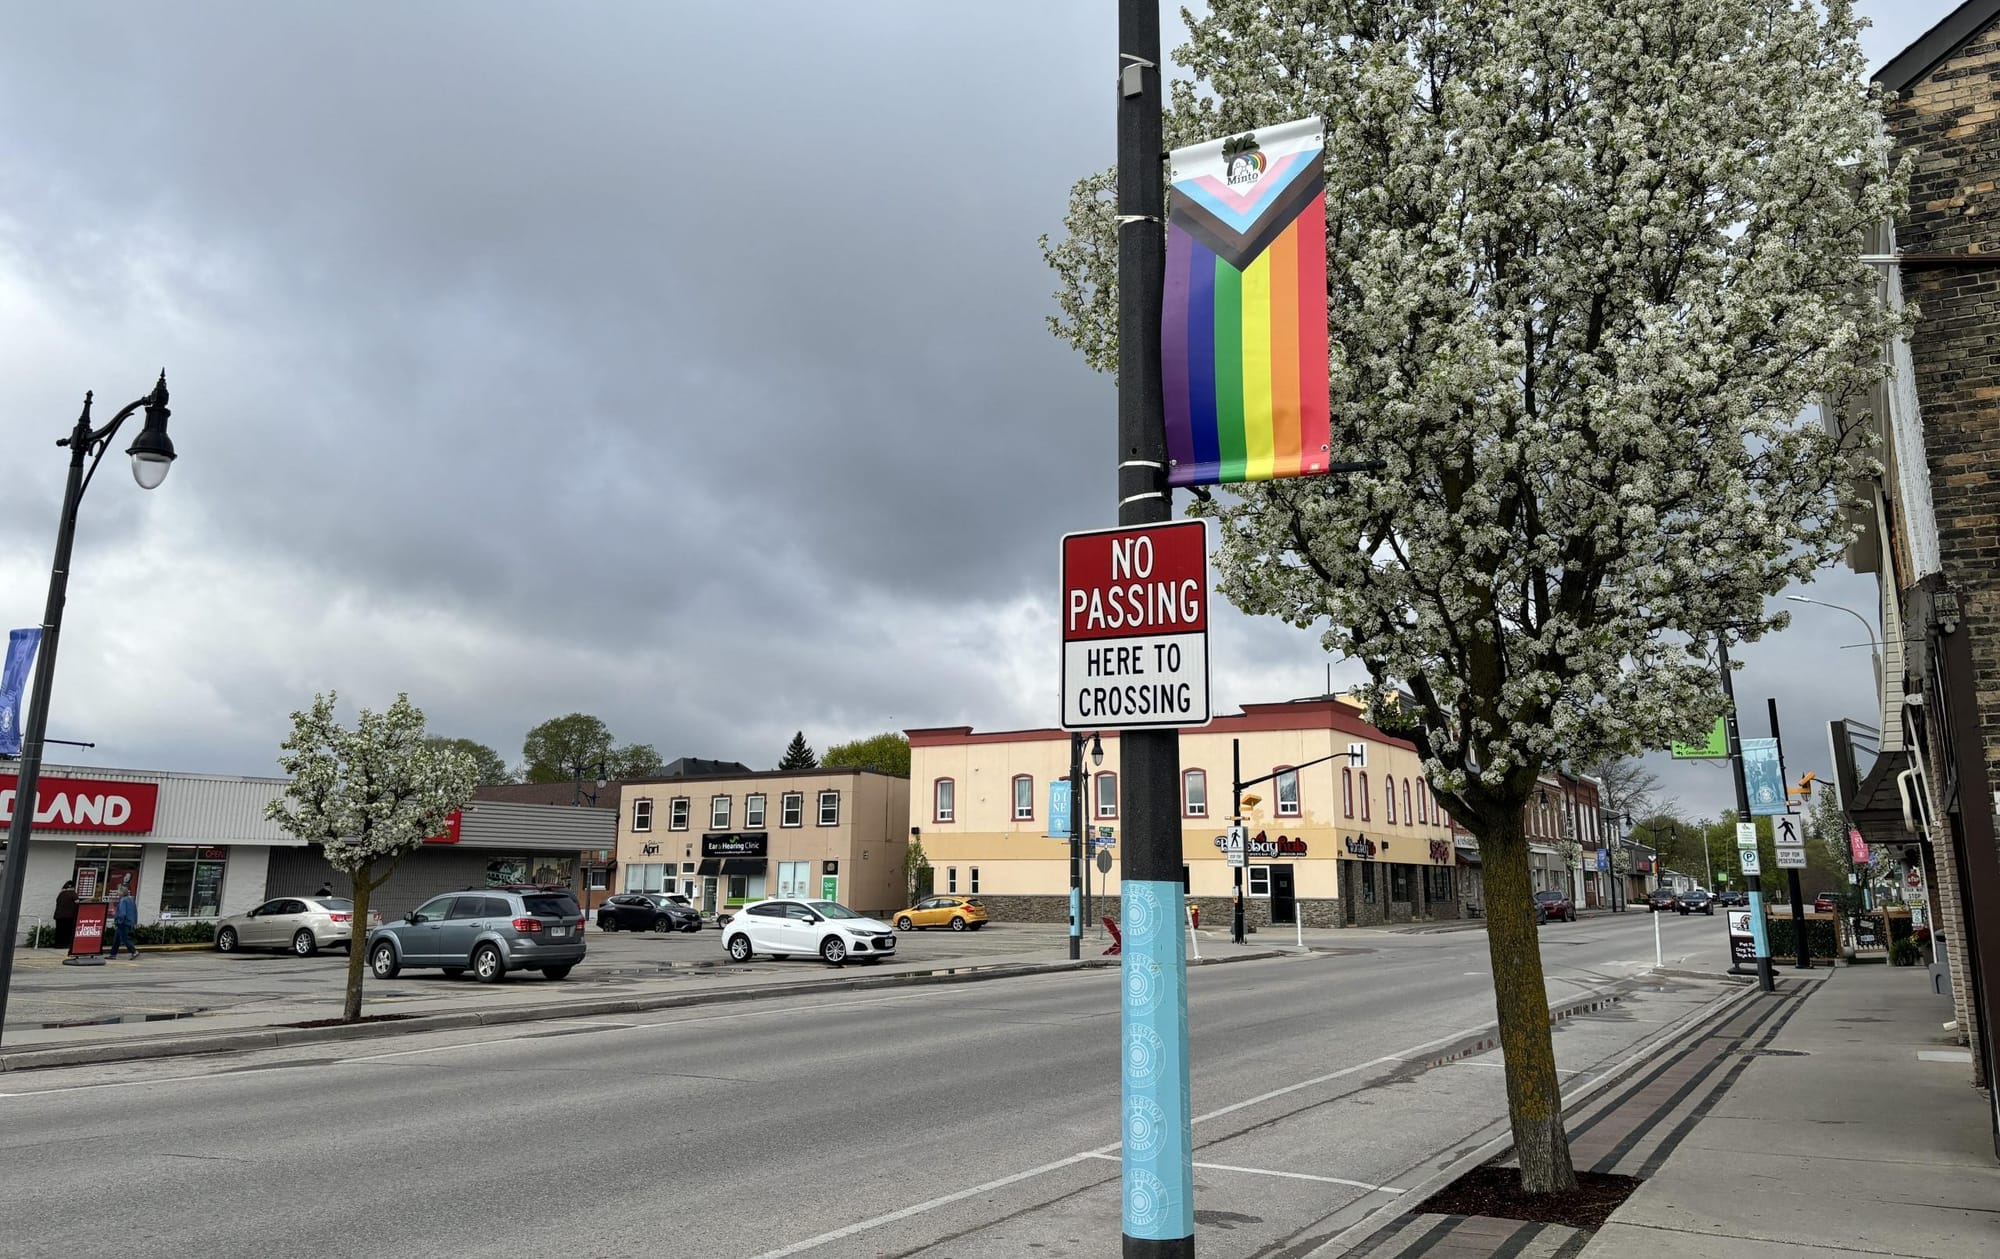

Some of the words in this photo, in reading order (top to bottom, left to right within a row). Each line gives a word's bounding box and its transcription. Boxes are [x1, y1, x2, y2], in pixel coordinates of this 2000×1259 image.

[1227, 172, 1258, 186] Minto
[1112, 535, 1154, 580] NO
[1070, 578, 1199, 632] PASSING
[1088, 646, 1144, 677] HERE
[1154, 643, 1181, 673] TO
[1079, 683, 1191, 717] CROSSING
[1351, 745, 1364, 767] H
[722, 842, 744, 851] Hearing
